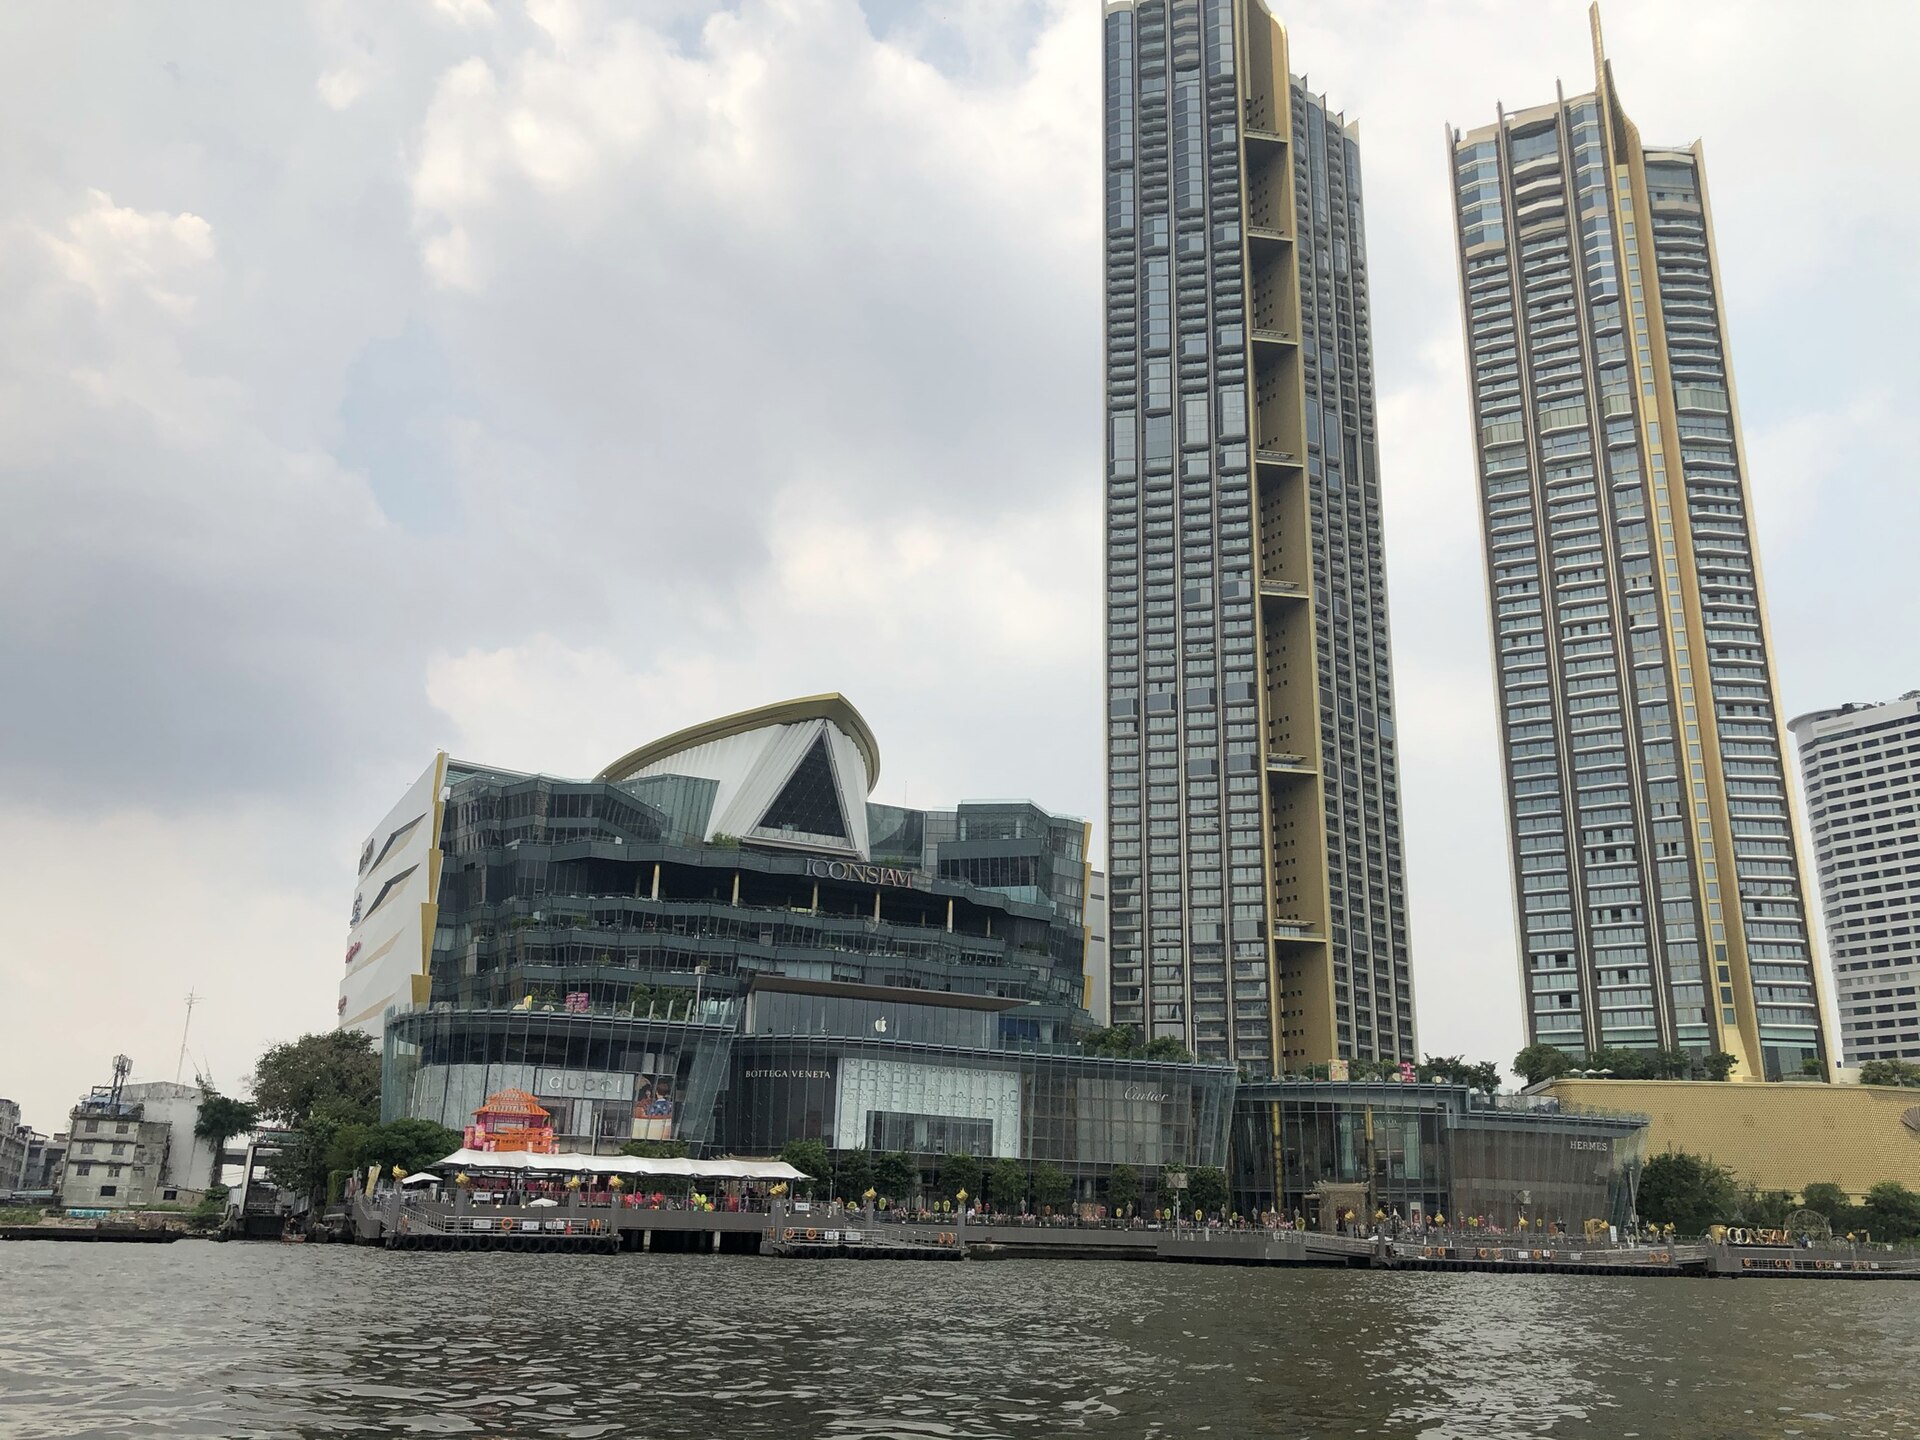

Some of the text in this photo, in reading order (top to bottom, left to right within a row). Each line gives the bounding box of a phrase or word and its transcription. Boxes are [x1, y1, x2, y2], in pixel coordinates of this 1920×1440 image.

[804, 858, 913, 889] ICONSIAM
[745, 1069, 831, 1079] BOTTEGA VENETA
[549, 1076, 621, 1093] GUCCI
[1124, 1086, 1169, 1102] Cartier
